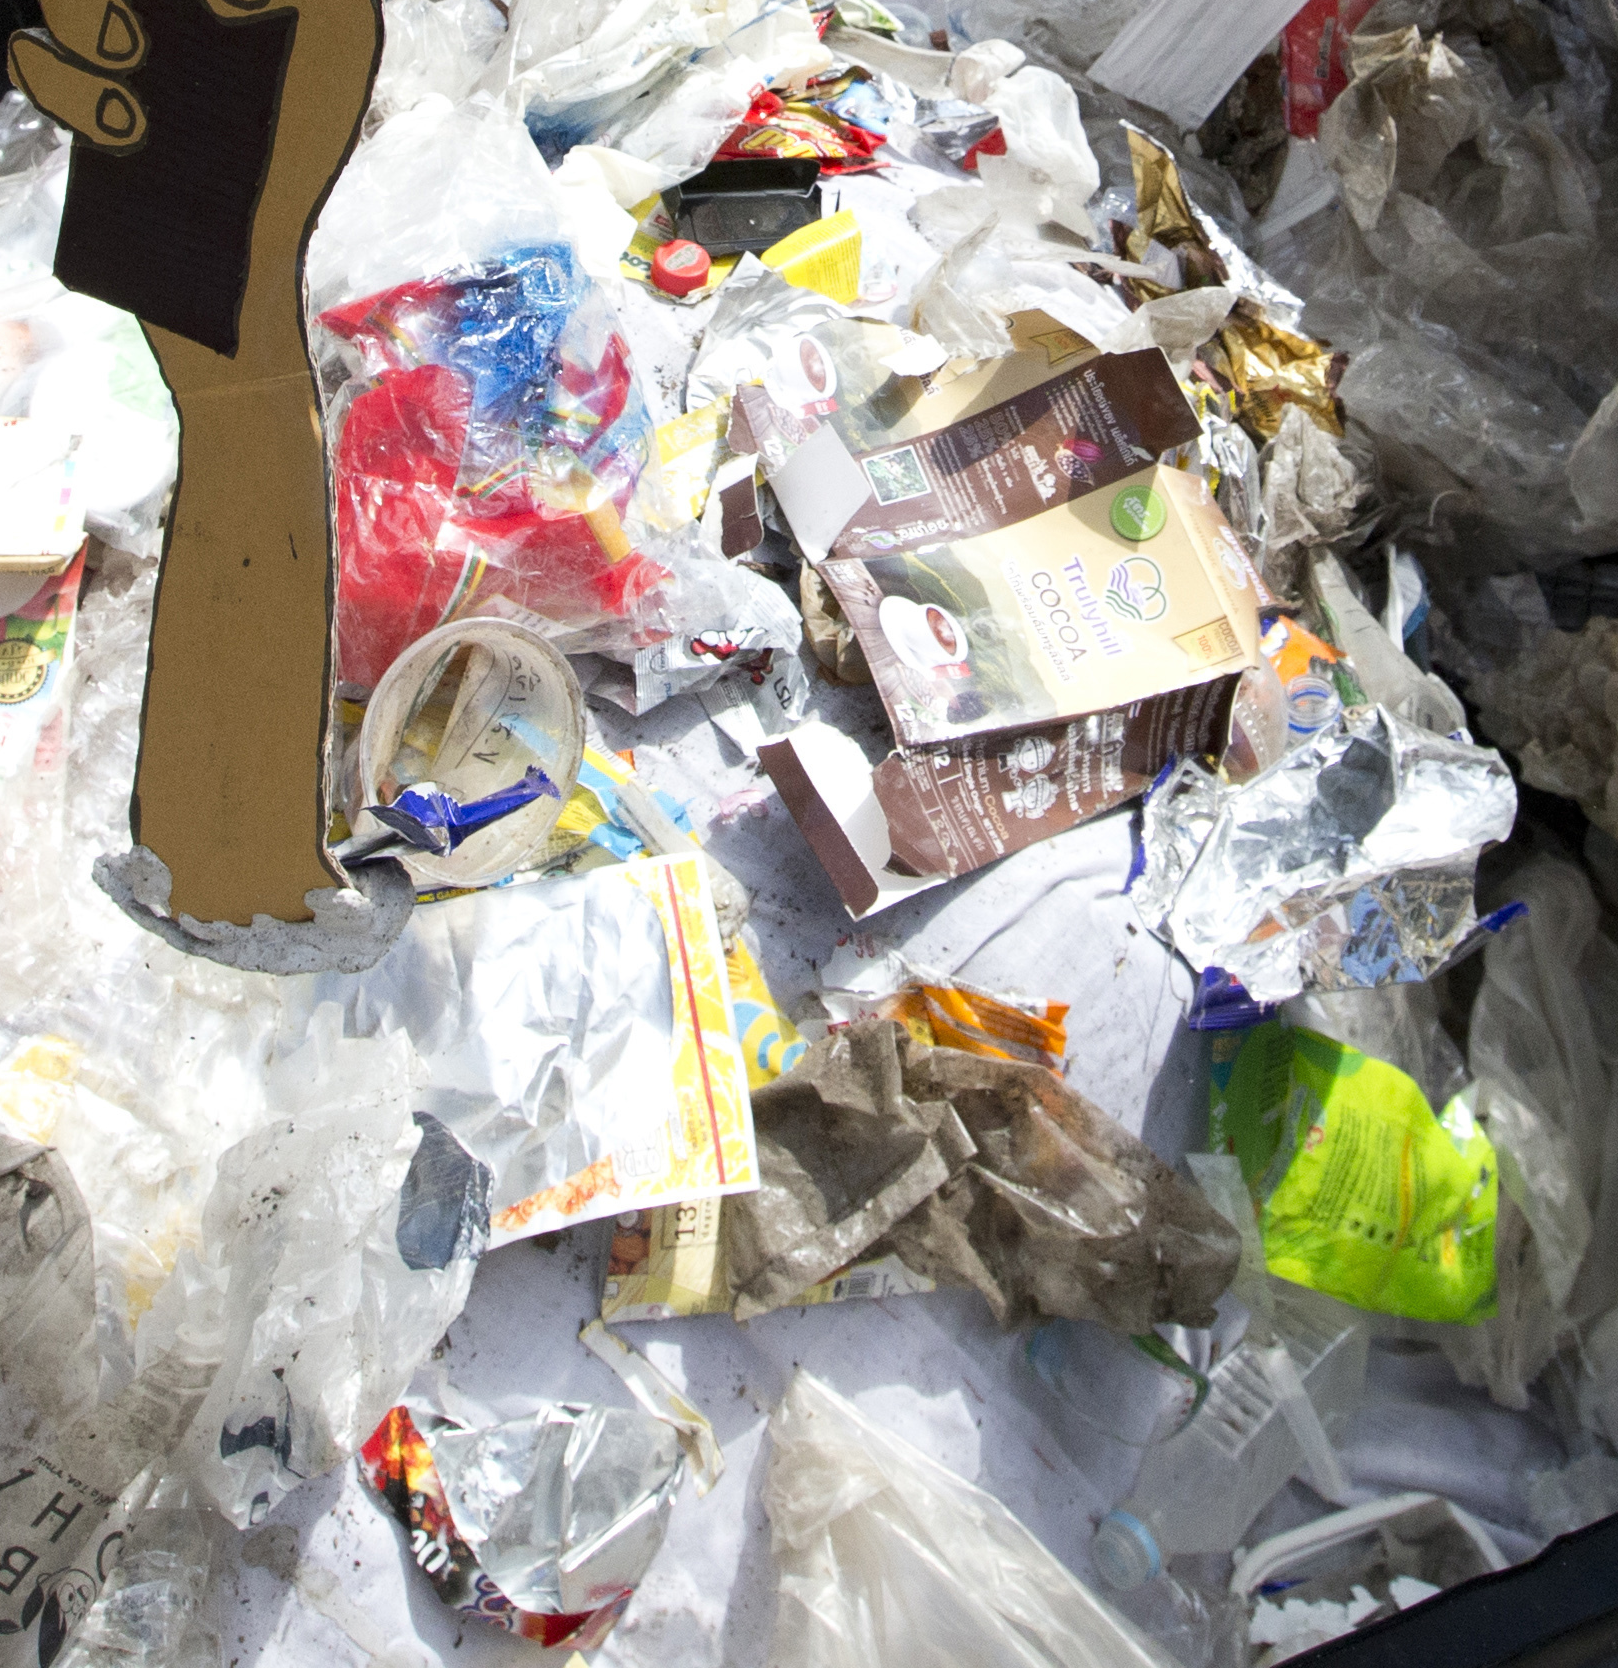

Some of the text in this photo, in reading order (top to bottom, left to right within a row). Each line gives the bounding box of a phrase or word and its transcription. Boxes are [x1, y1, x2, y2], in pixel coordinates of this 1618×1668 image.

[1032, 572, 1087, 663] COCOA
[1063, 556, 1123, 656] Trulyhill
[675, 1205, 698, 1243] 13
